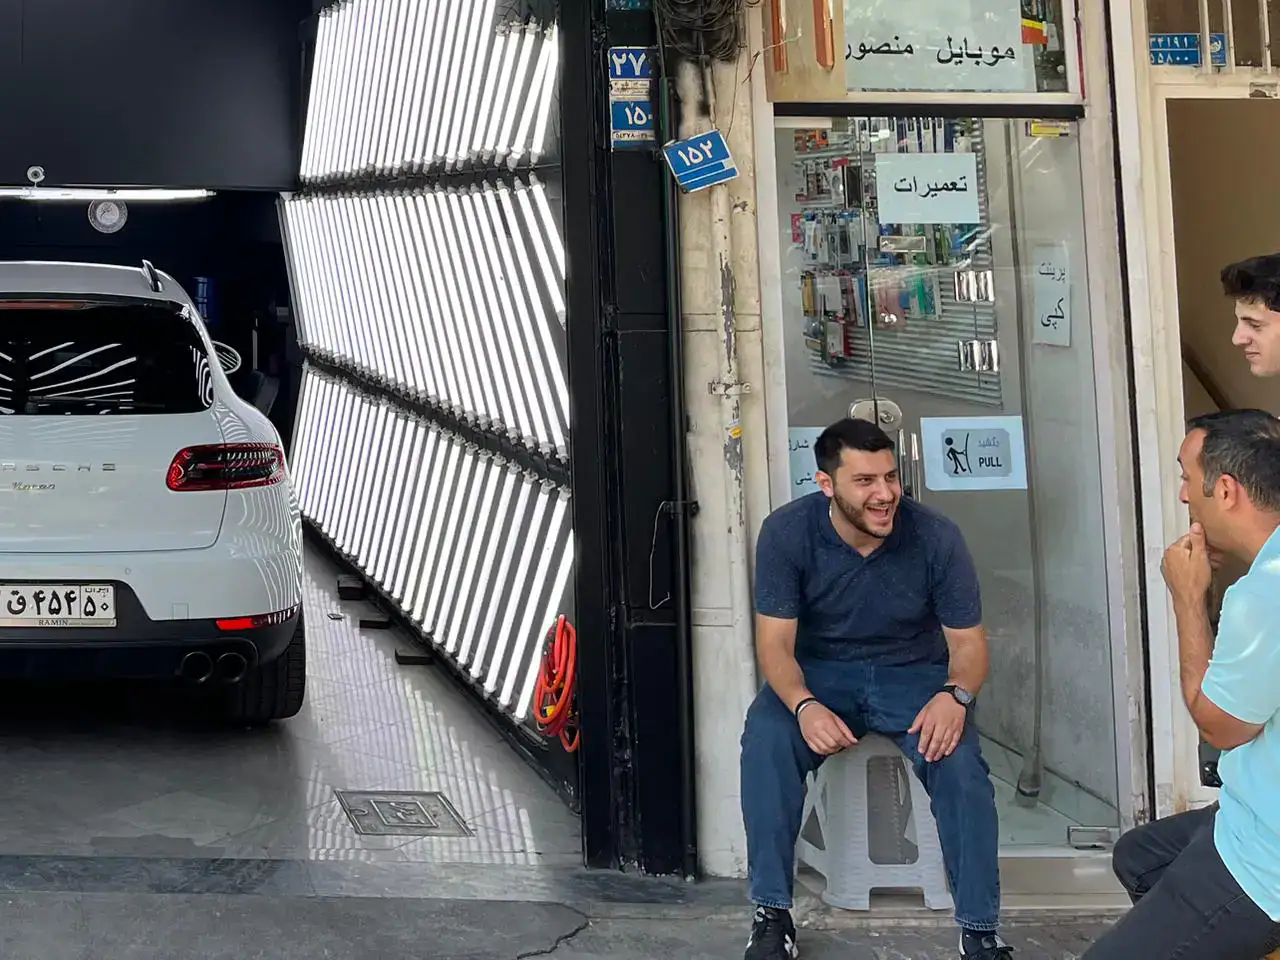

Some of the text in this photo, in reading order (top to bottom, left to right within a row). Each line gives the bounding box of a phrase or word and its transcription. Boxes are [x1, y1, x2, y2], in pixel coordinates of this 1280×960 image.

[845, 35, 1015, 66] موبایل منصور
[677, 140, 713, 166] ۱۵۲
[894, 175, 968, 198] تعمیرات
[1039, 262, 1066, 284] پرینت
[1041, 297, 1065, 330] کپی
[978, 456, 1002, 468] PULL
[7, 591, 27, 615] ق
[32, 590, 77, 615] ۴۵۴
[83, 595, 110, 617] ۵۰
